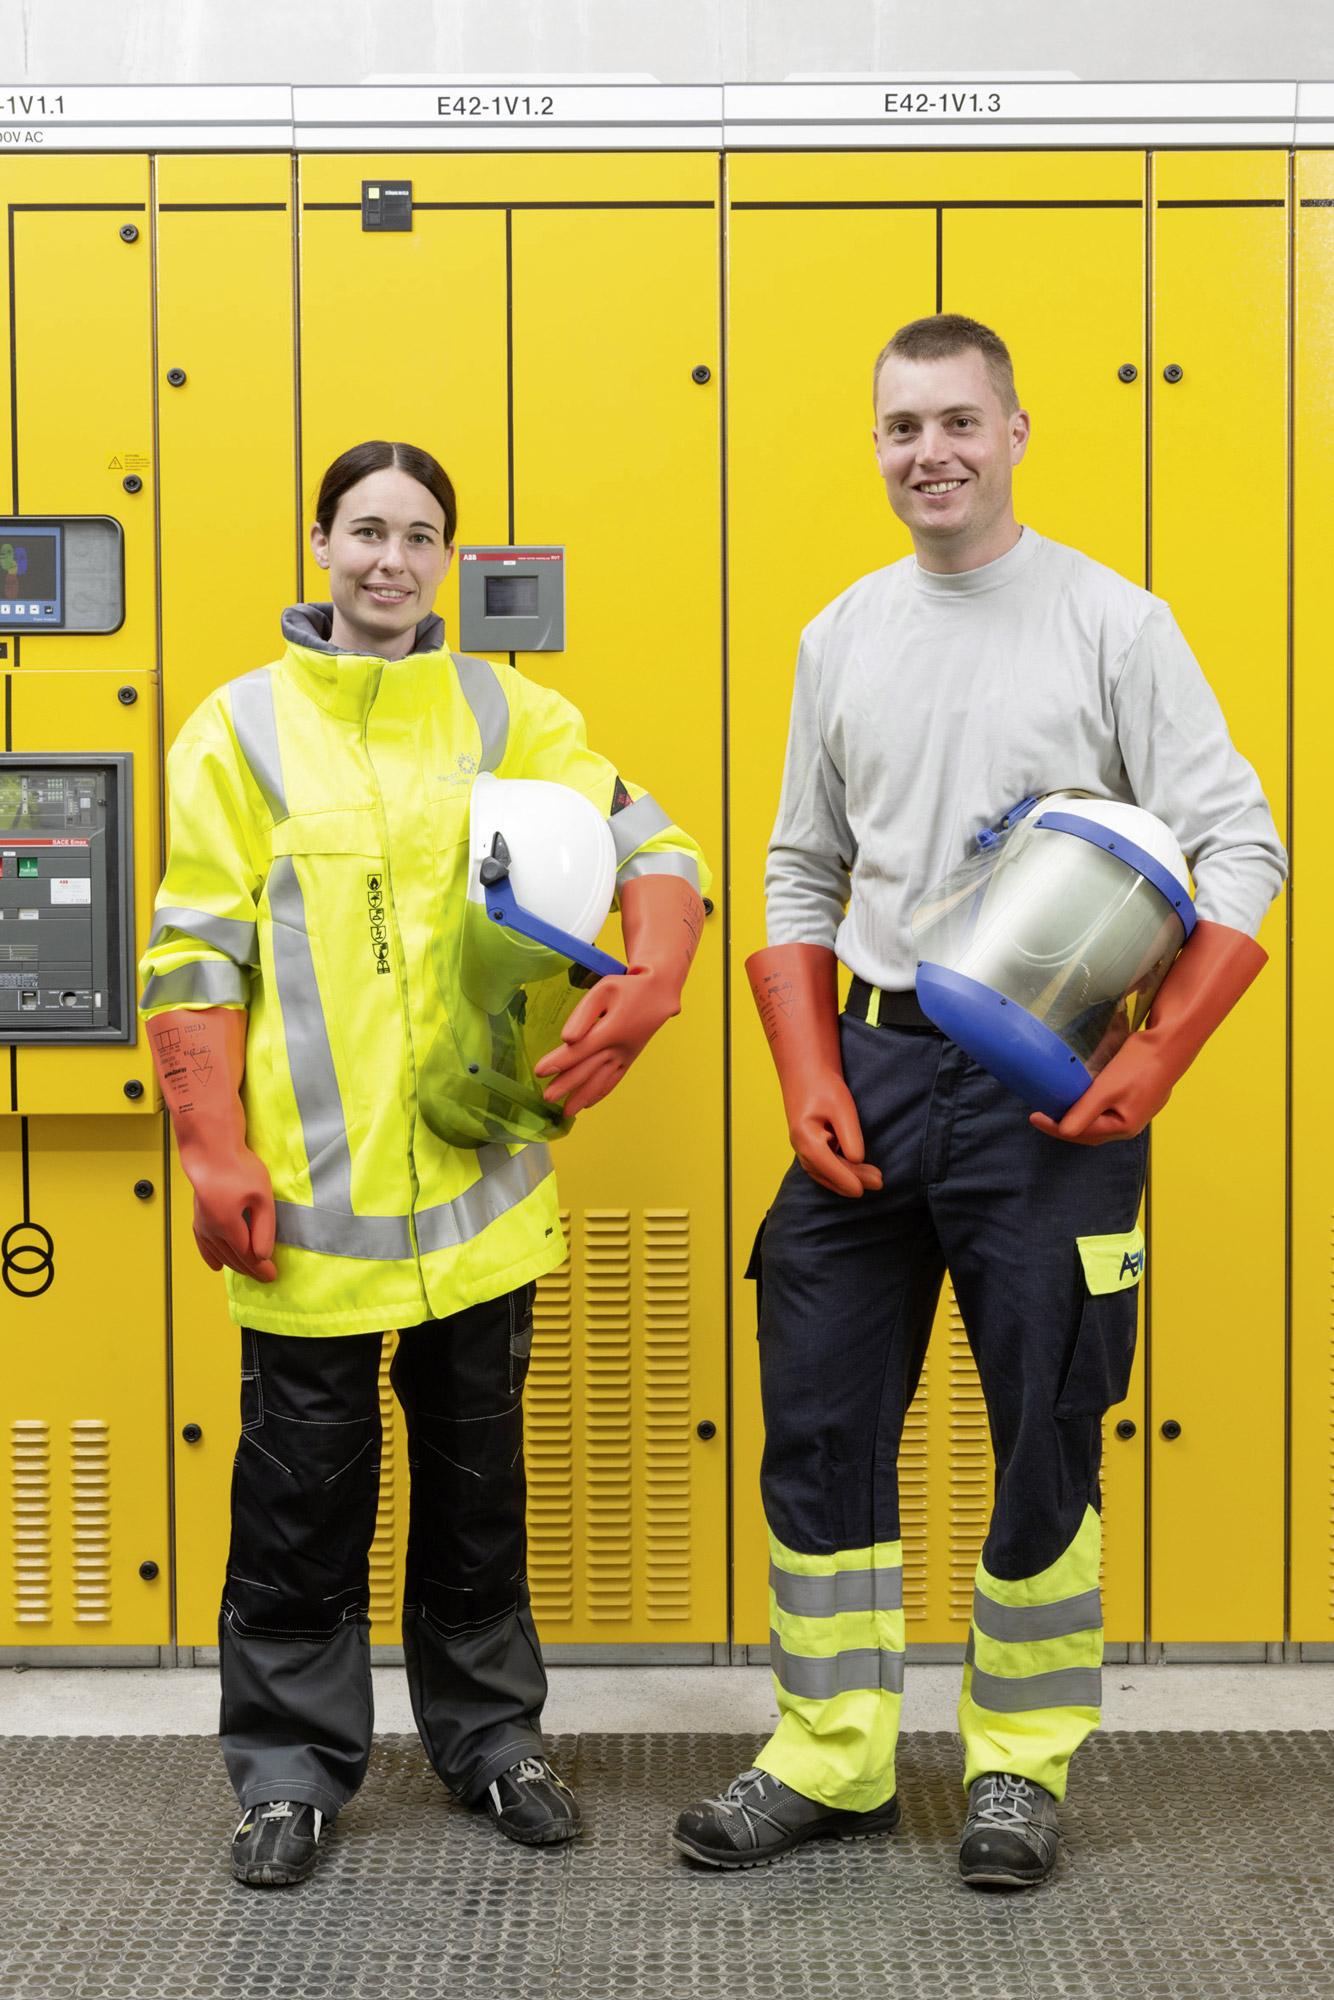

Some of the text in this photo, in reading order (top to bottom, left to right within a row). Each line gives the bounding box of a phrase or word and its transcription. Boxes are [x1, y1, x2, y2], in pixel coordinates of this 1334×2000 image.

[0, 95, 64, 114] -1V1.1
[437, 96, 554, 115] E42-1V1.2
[884, 93, 1001, 112] E42-1V1.3
[25, 131, 44, 143] AC
